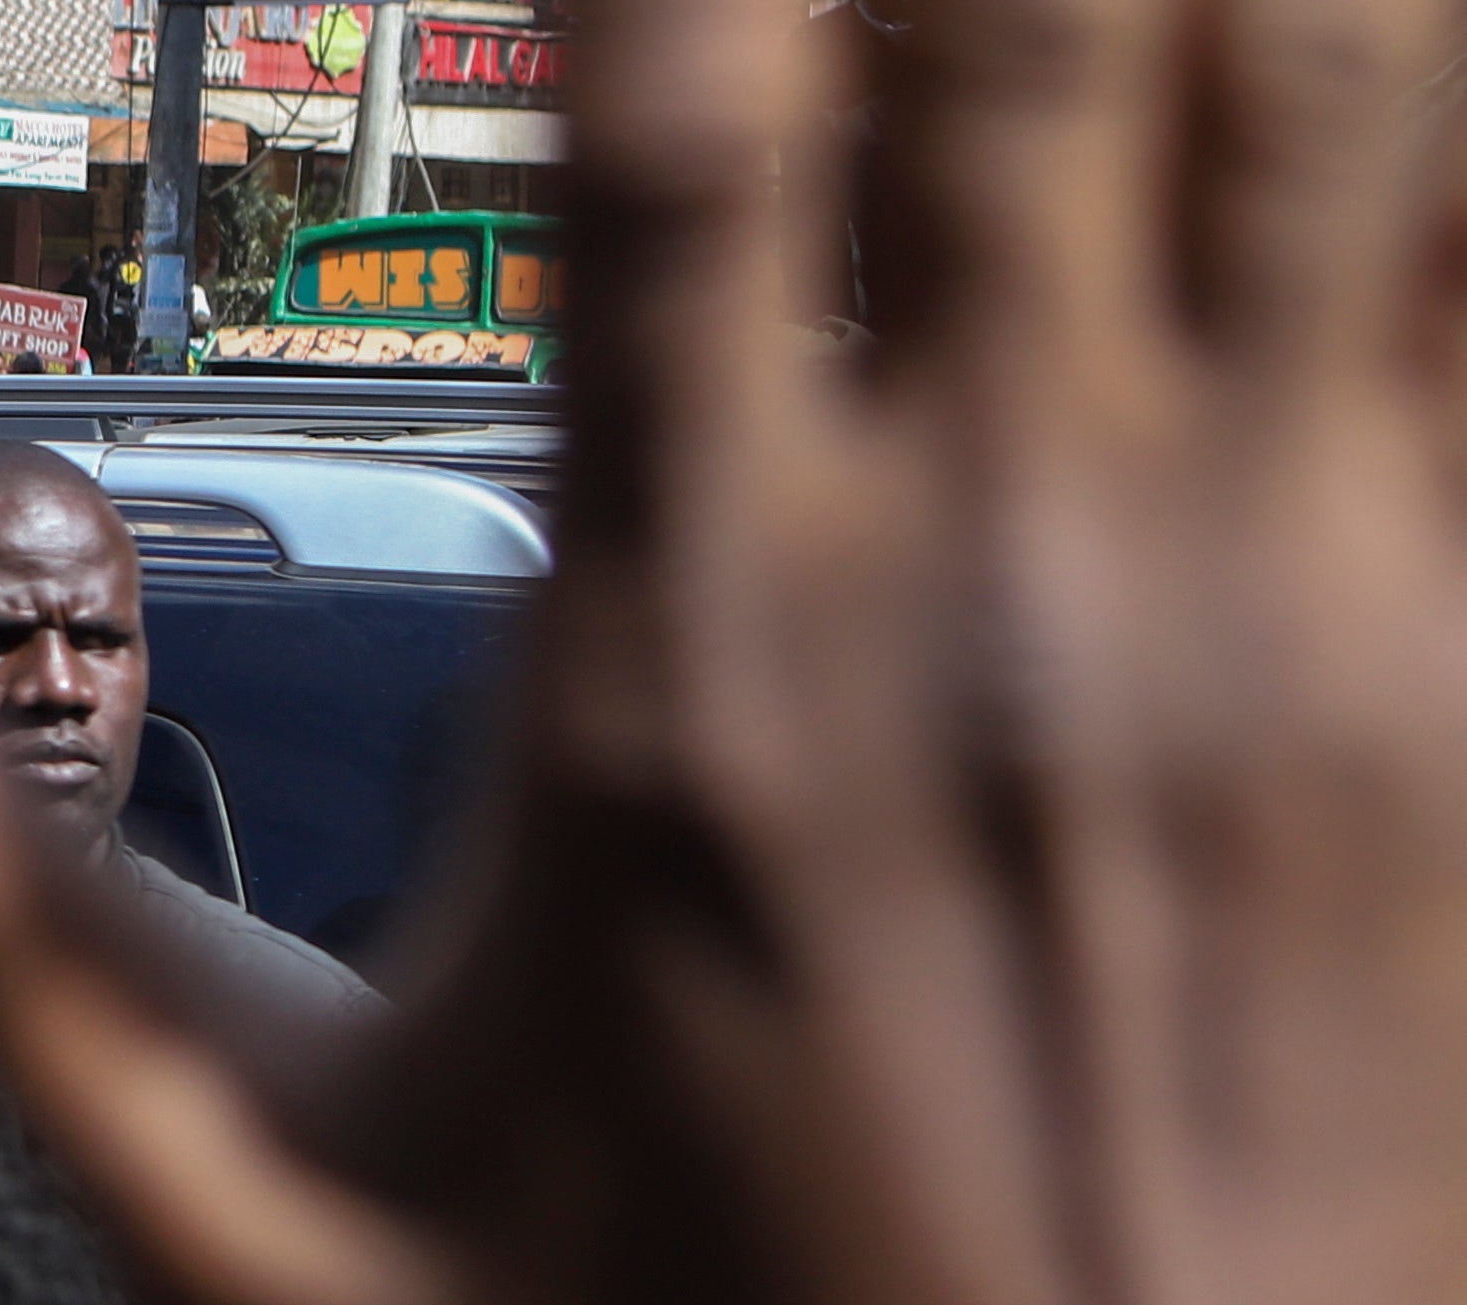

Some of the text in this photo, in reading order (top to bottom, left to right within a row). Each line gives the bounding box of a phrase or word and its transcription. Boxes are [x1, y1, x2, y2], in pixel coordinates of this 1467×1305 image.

[418, 34, 505, 84] HILAL
[318, 247, 471, 311] WIS
[25, 333, 70, 358] SHOP
[216, 326, 535, 365] WISDOM
